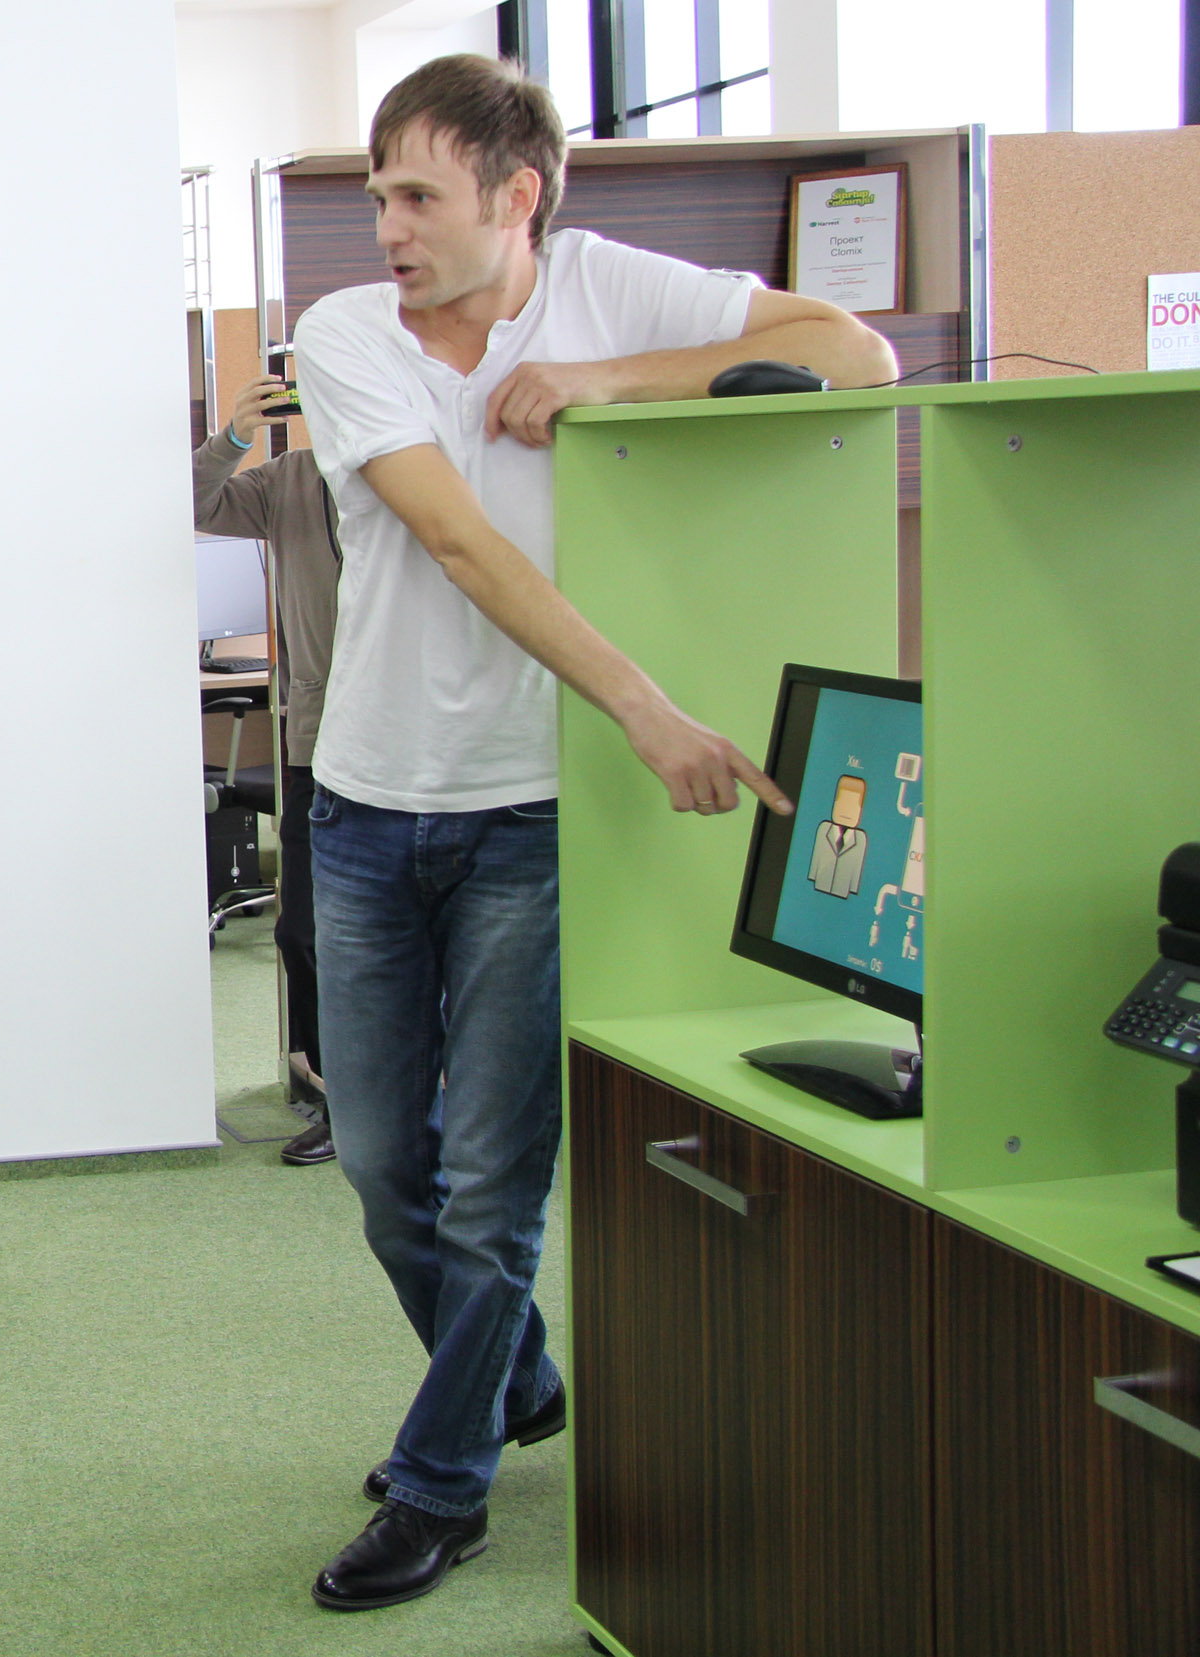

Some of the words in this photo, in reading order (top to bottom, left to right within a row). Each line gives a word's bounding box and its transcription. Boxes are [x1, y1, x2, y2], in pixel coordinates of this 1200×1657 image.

[829, 236, 864, 246] Проект
[830, 248, 863, 257] Clomix
[1152, 293, 1175, 304] THE
[1152, 337, 1173, 349] DO
